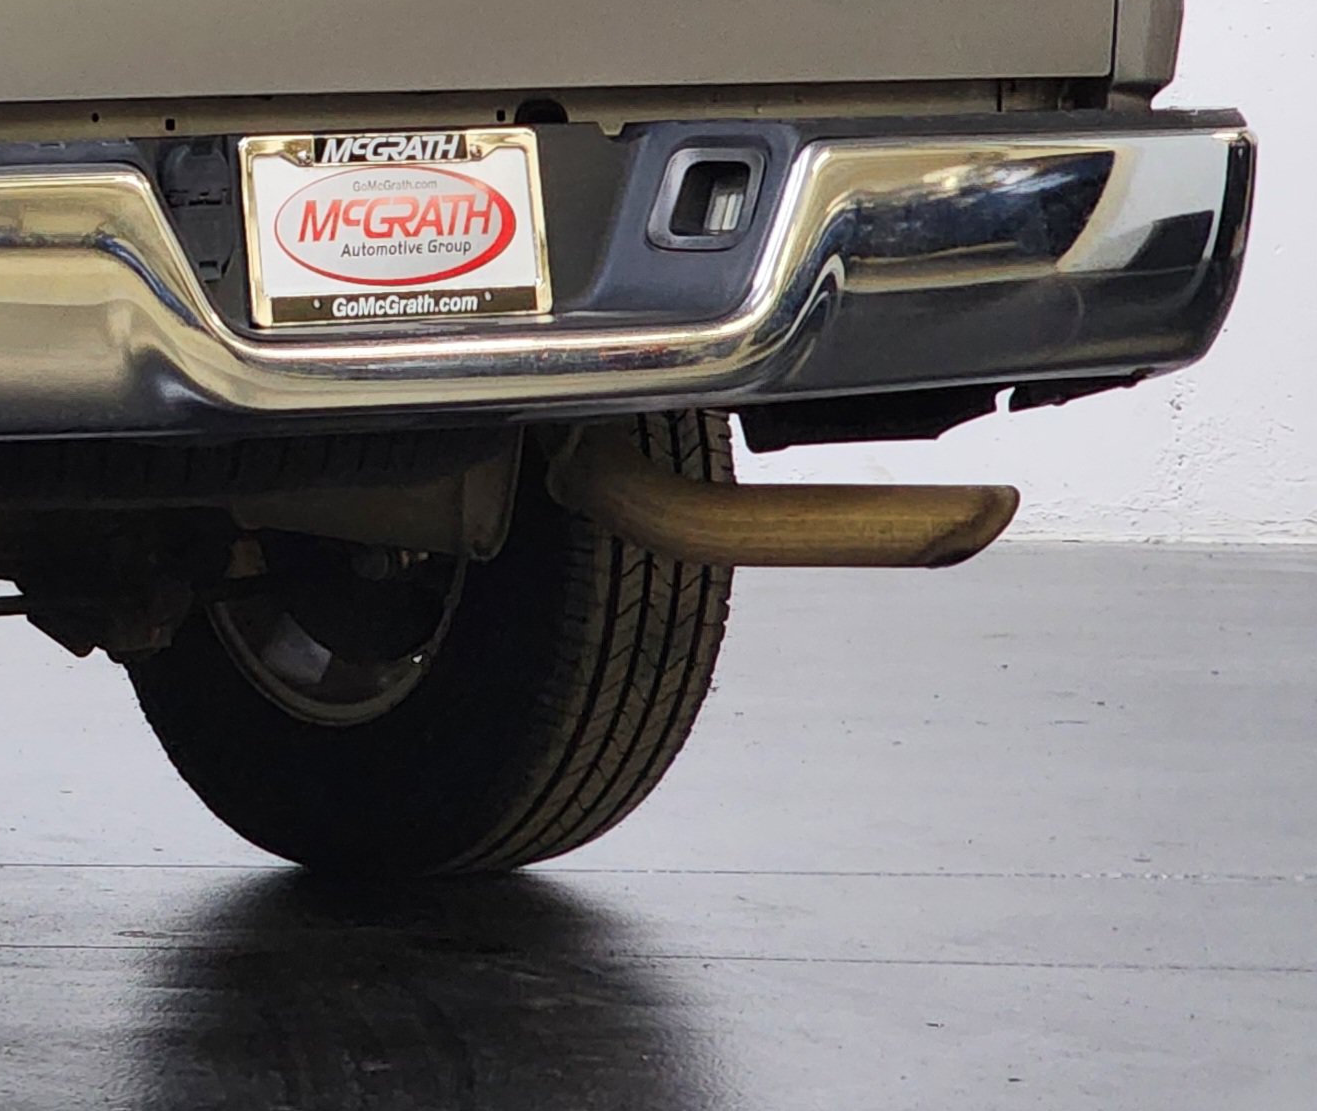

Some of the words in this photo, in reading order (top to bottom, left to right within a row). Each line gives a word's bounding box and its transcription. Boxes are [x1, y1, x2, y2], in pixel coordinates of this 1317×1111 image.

[352, 179, 438, 192] GoMcGrath.com
[340, 242, 423, 258] Automotive
[428, 239, 472, 256] Group
[332, 293, 478, 317] GoMcGrath.com
